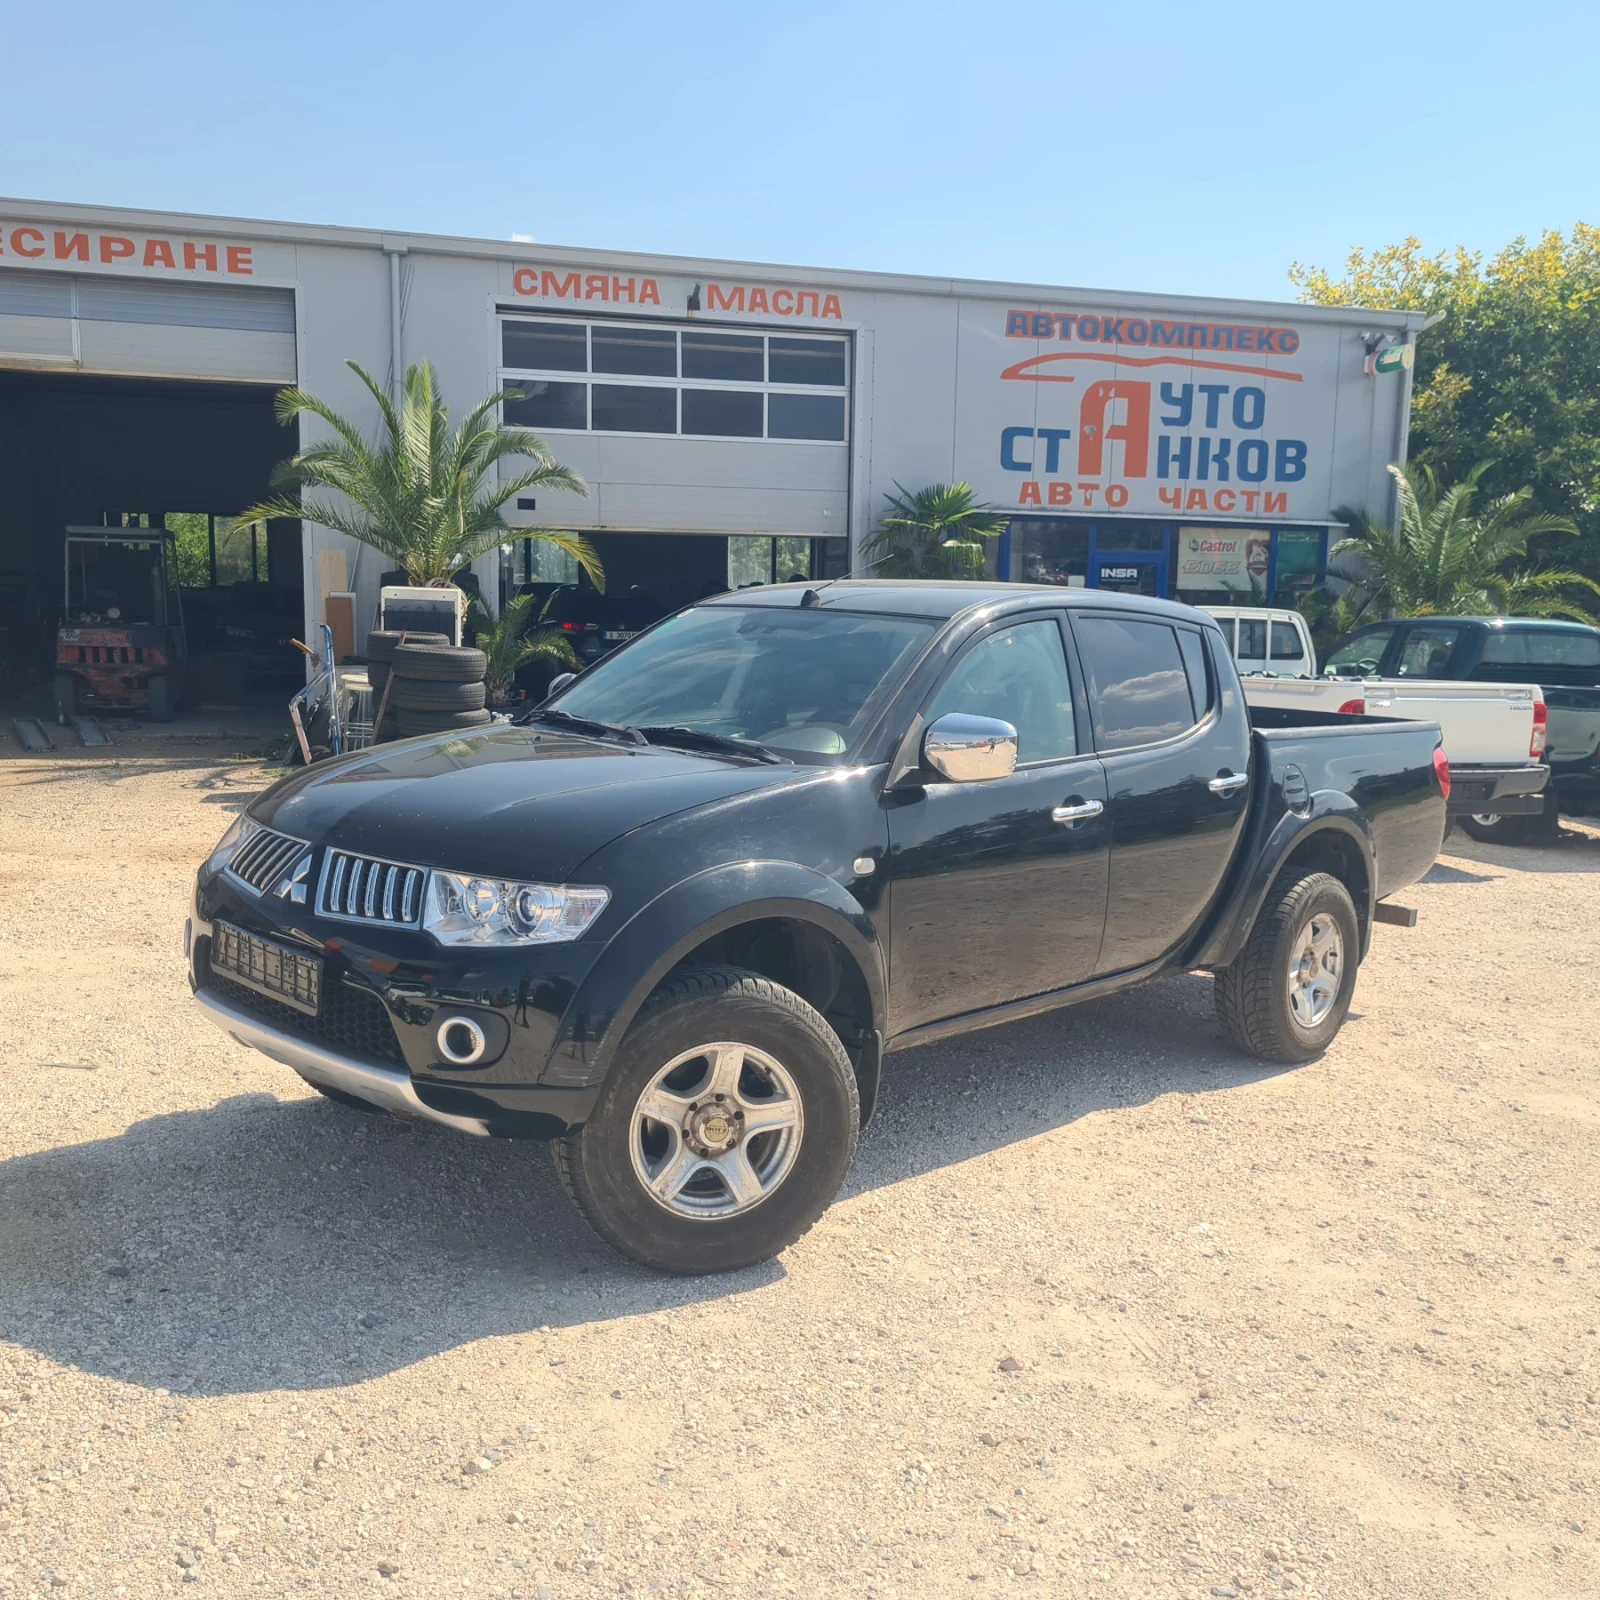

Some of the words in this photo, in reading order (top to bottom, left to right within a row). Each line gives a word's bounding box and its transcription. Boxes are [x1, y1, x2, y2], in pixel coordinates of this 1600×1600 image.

[0, 227, 253, 274] СИРАНЕ
[514, 268, 660, 305] СМЯНА
[707, 284, 842, 319] МАСЛА
[1005, 310, 1300, 355] АВТОКОМПЛЕКС
[1018, 481, 1129, 507] АВТО
[1158, 487, 1288, 513] ЧАСТИ
[1200, 540, 1237, 552] Castrol
[1101, 568, 1138, 578] INSA
[1182, 560, 1241, 575] EDGE
